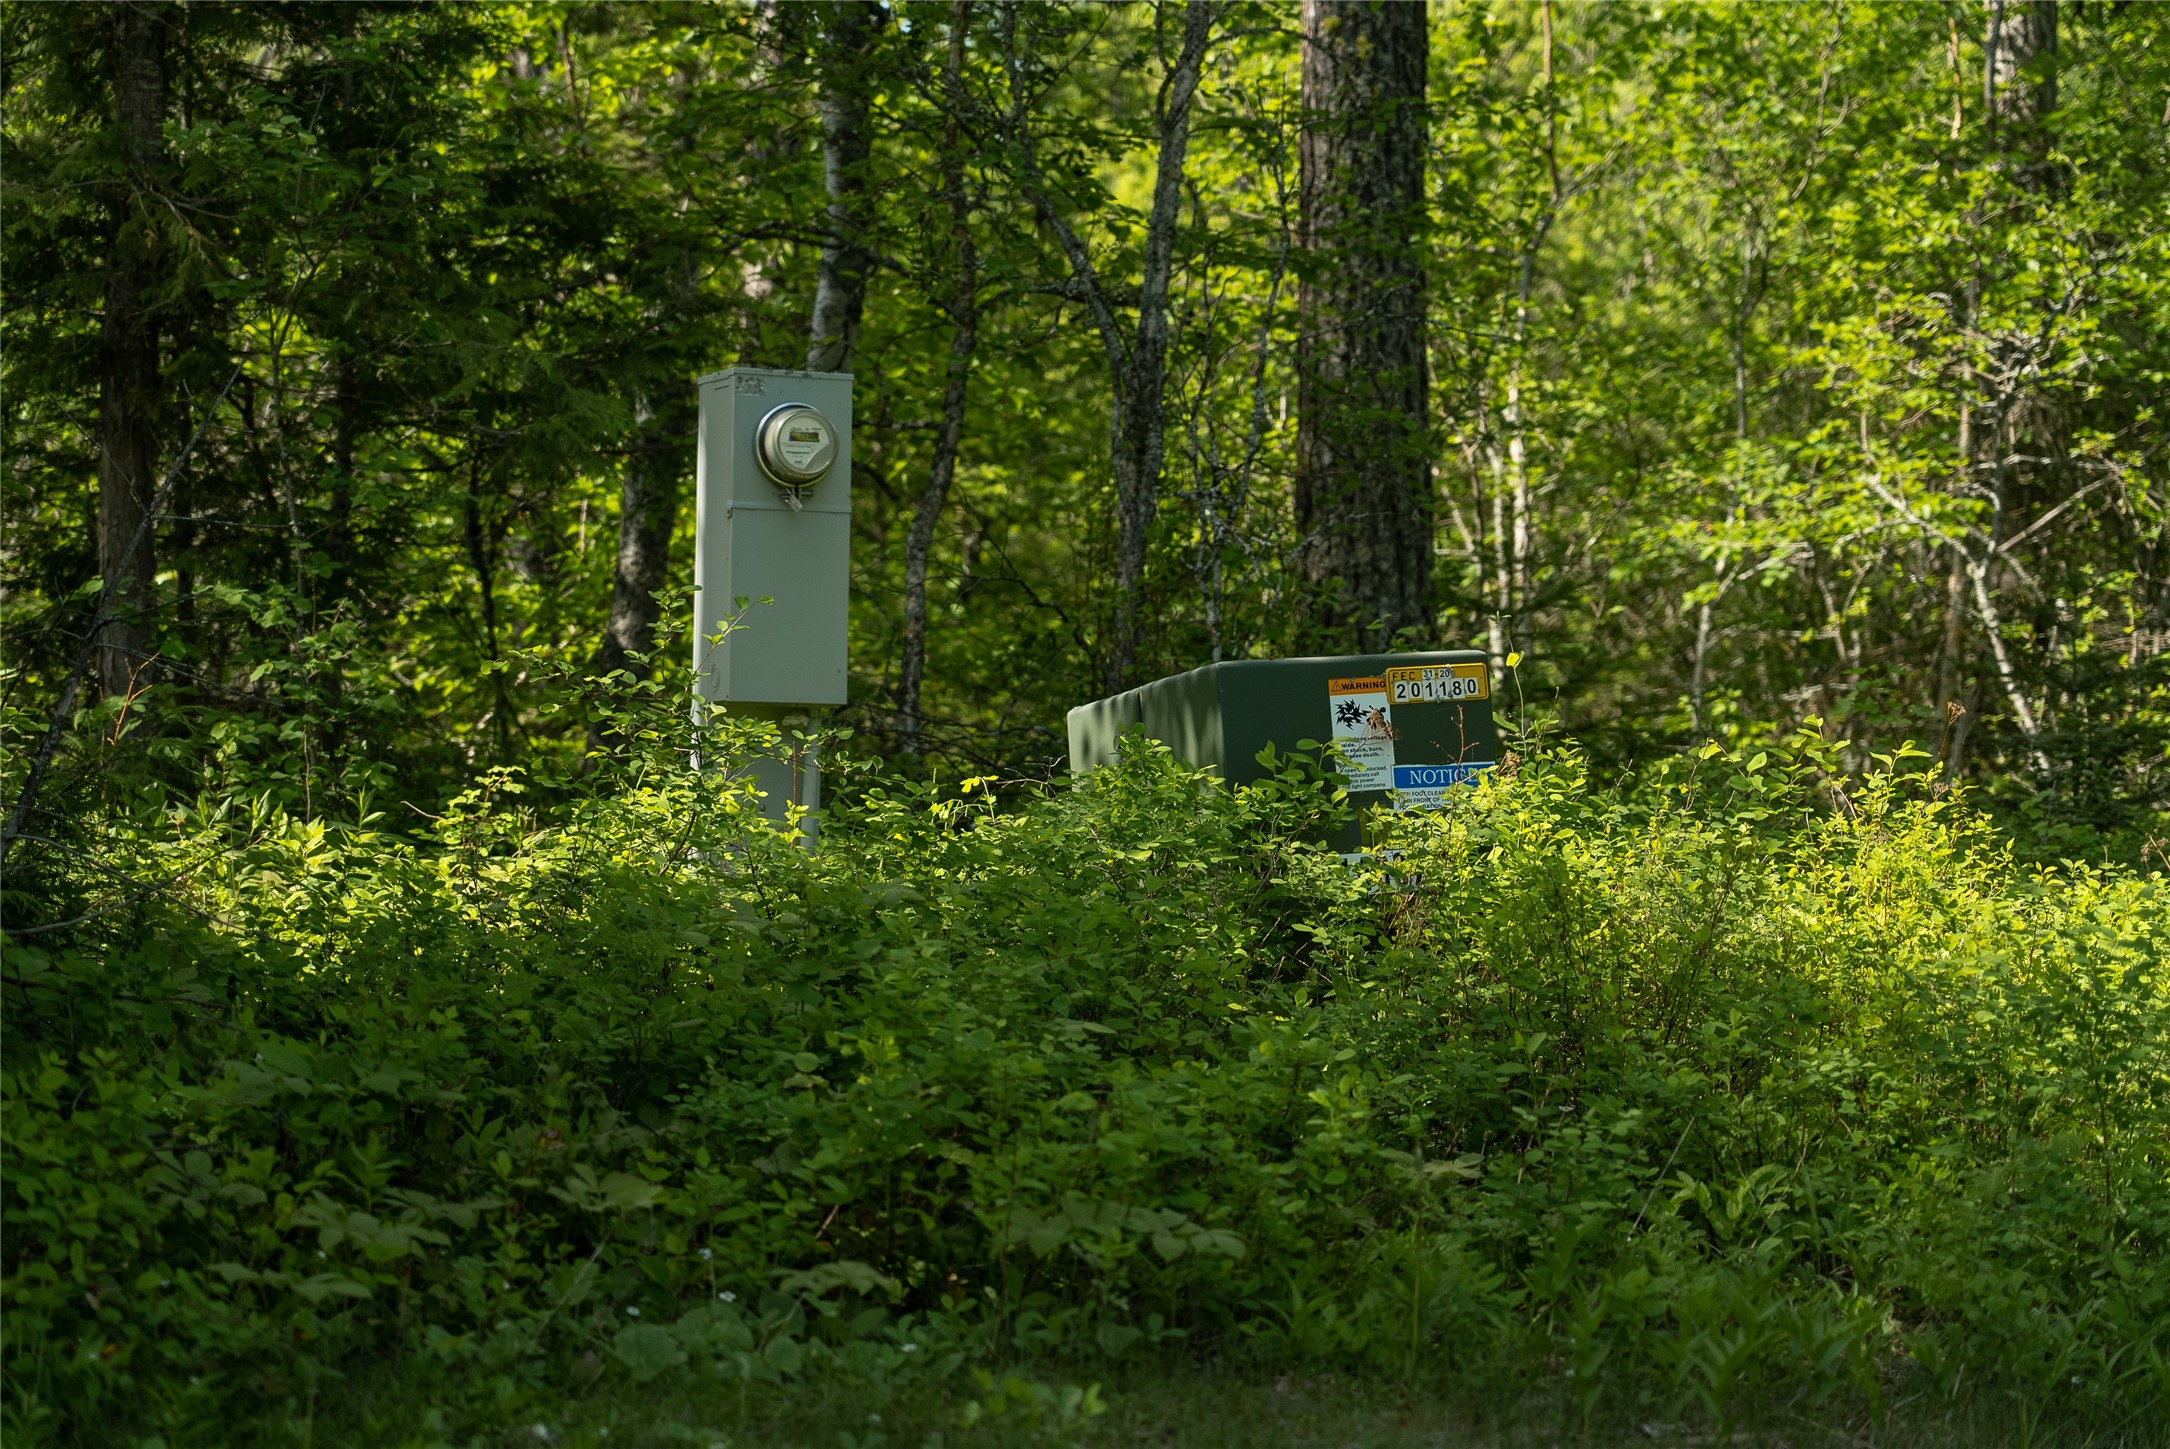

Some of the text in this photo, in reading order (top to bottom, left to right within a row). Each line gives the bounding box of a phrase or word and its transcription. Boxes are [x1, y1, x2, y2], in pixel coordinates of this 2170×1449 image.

[1392, 671, 1415, 680] FEC
[1341, 680, 1386, 691] WARNING
[1396, 679, 1477, 698] 201180
